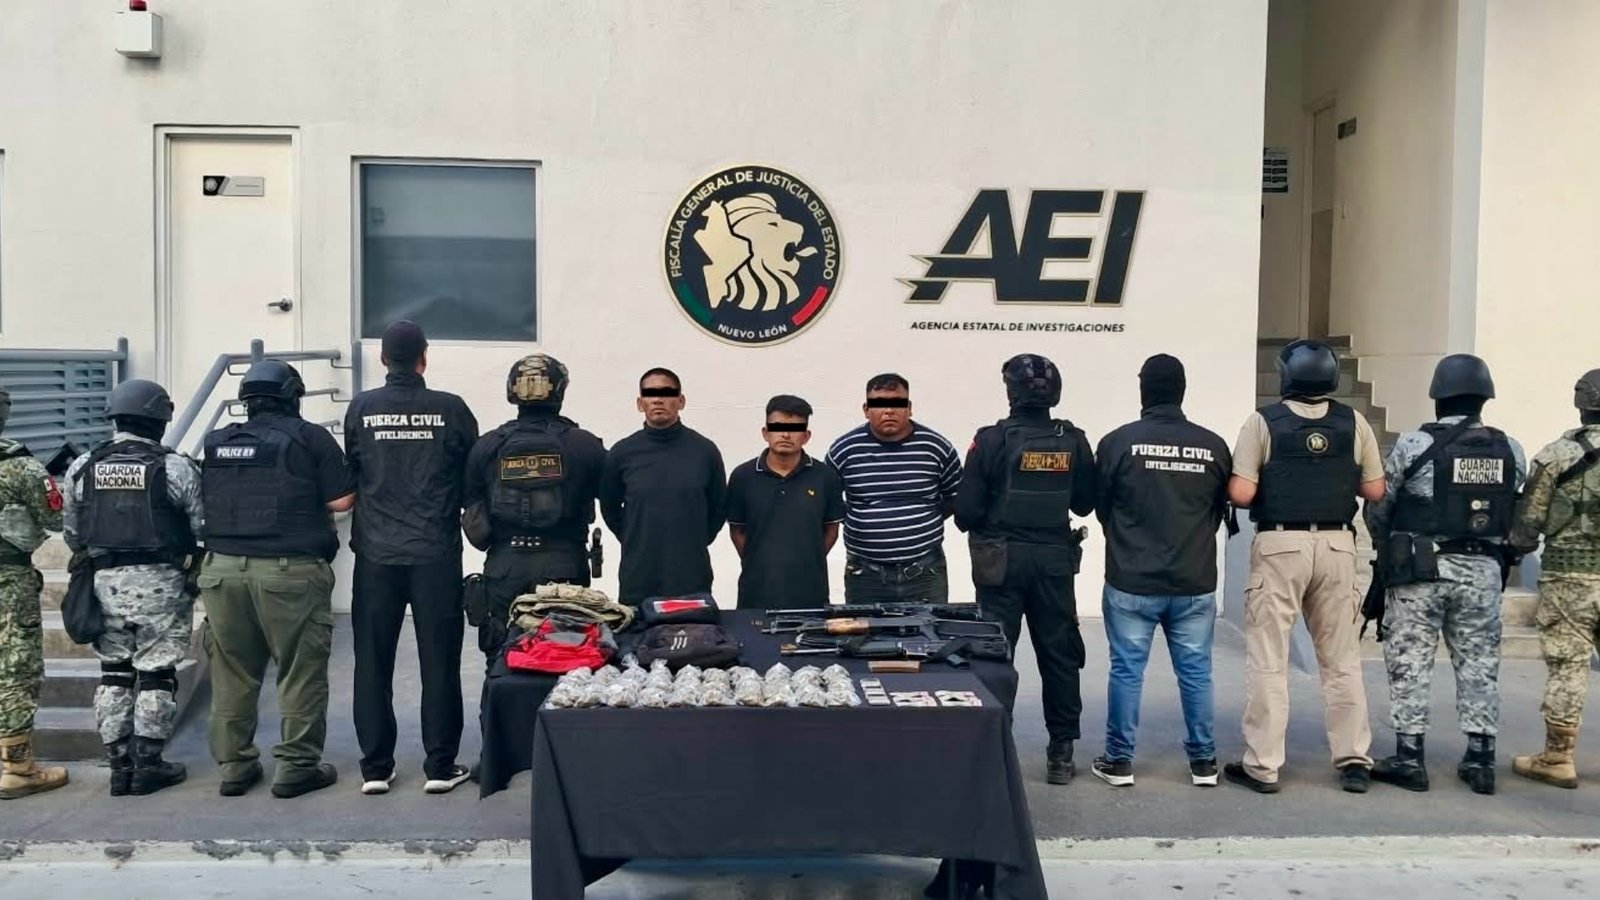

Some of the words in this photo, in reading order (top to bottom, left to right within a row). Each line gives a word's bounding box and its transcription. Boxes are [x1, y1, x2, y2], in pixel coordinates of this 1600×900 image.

[669, 219, 687, 278] FISCALÍA
[680, 174, 733, 219] GENERAL
[735, 170, 754, 183] DE
[756, 171, 809, 204] JUSTICIA
[808, 200, 828, 226] DEL
[821, 226, 836, 280] ESTADO
[896, 188, 1146, 306] AEI
[717, 324, 755, 339] NUEVO
[759, 324, 787, 338] LEÓN
[911, 321, 960, 331] AGENCIA
[962, 322, 1007, 331] ESTATAL
[1009, 323, 1024, 331] DE
[1026, 323, 1125, 333] INVESTIGACIONES
[363, 414, 409, 428] FUERZA
[411, 414, 446, 427] CIVIL
[374, 430, 434, 441] INTELIGENCIA
[216, 447, 242, 458] POLICE
[1131, 444, 1180, 458] FUERZA
[1182, 446, 1214, 462] CIVIL
[503, 459, 525, 469] FUERZA
[541, 457, 556, 466] CIVIL
[1023, 453, 1045, 469] FUERZA
[1053, 453, 1068, 469] CIVIL
[1145, 460, 1205, 473] INTELIGENCIA
[1460, 459, 1500, 471] GUARDIA
[97, 465, 142, 476] GUARDIA
[96, 476, 143, 488] NACIONAL
[1458, 471, 1499, 484] NACIONAL
